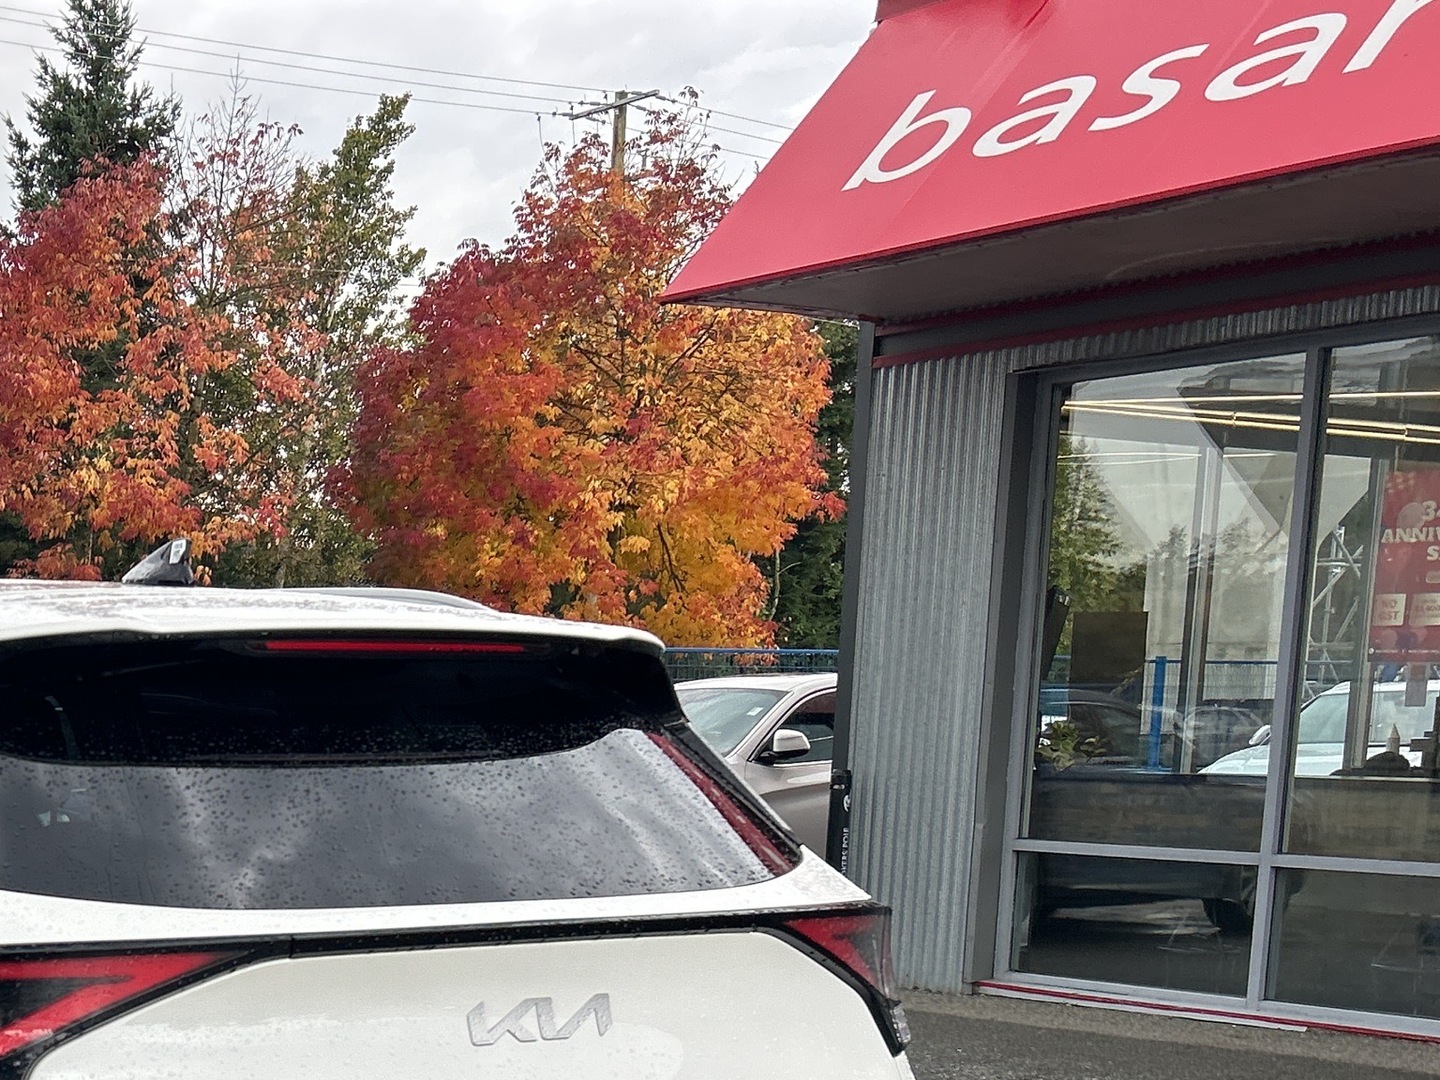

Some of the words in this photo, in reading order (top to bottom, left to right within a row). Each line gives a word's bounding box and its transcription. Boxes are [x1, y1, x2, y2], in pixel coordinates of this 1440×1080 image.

[1421, 500, 1440, 521] 3
[1426, 545, 1440, 561] S
[466, 993, 613, 1047] KIA
